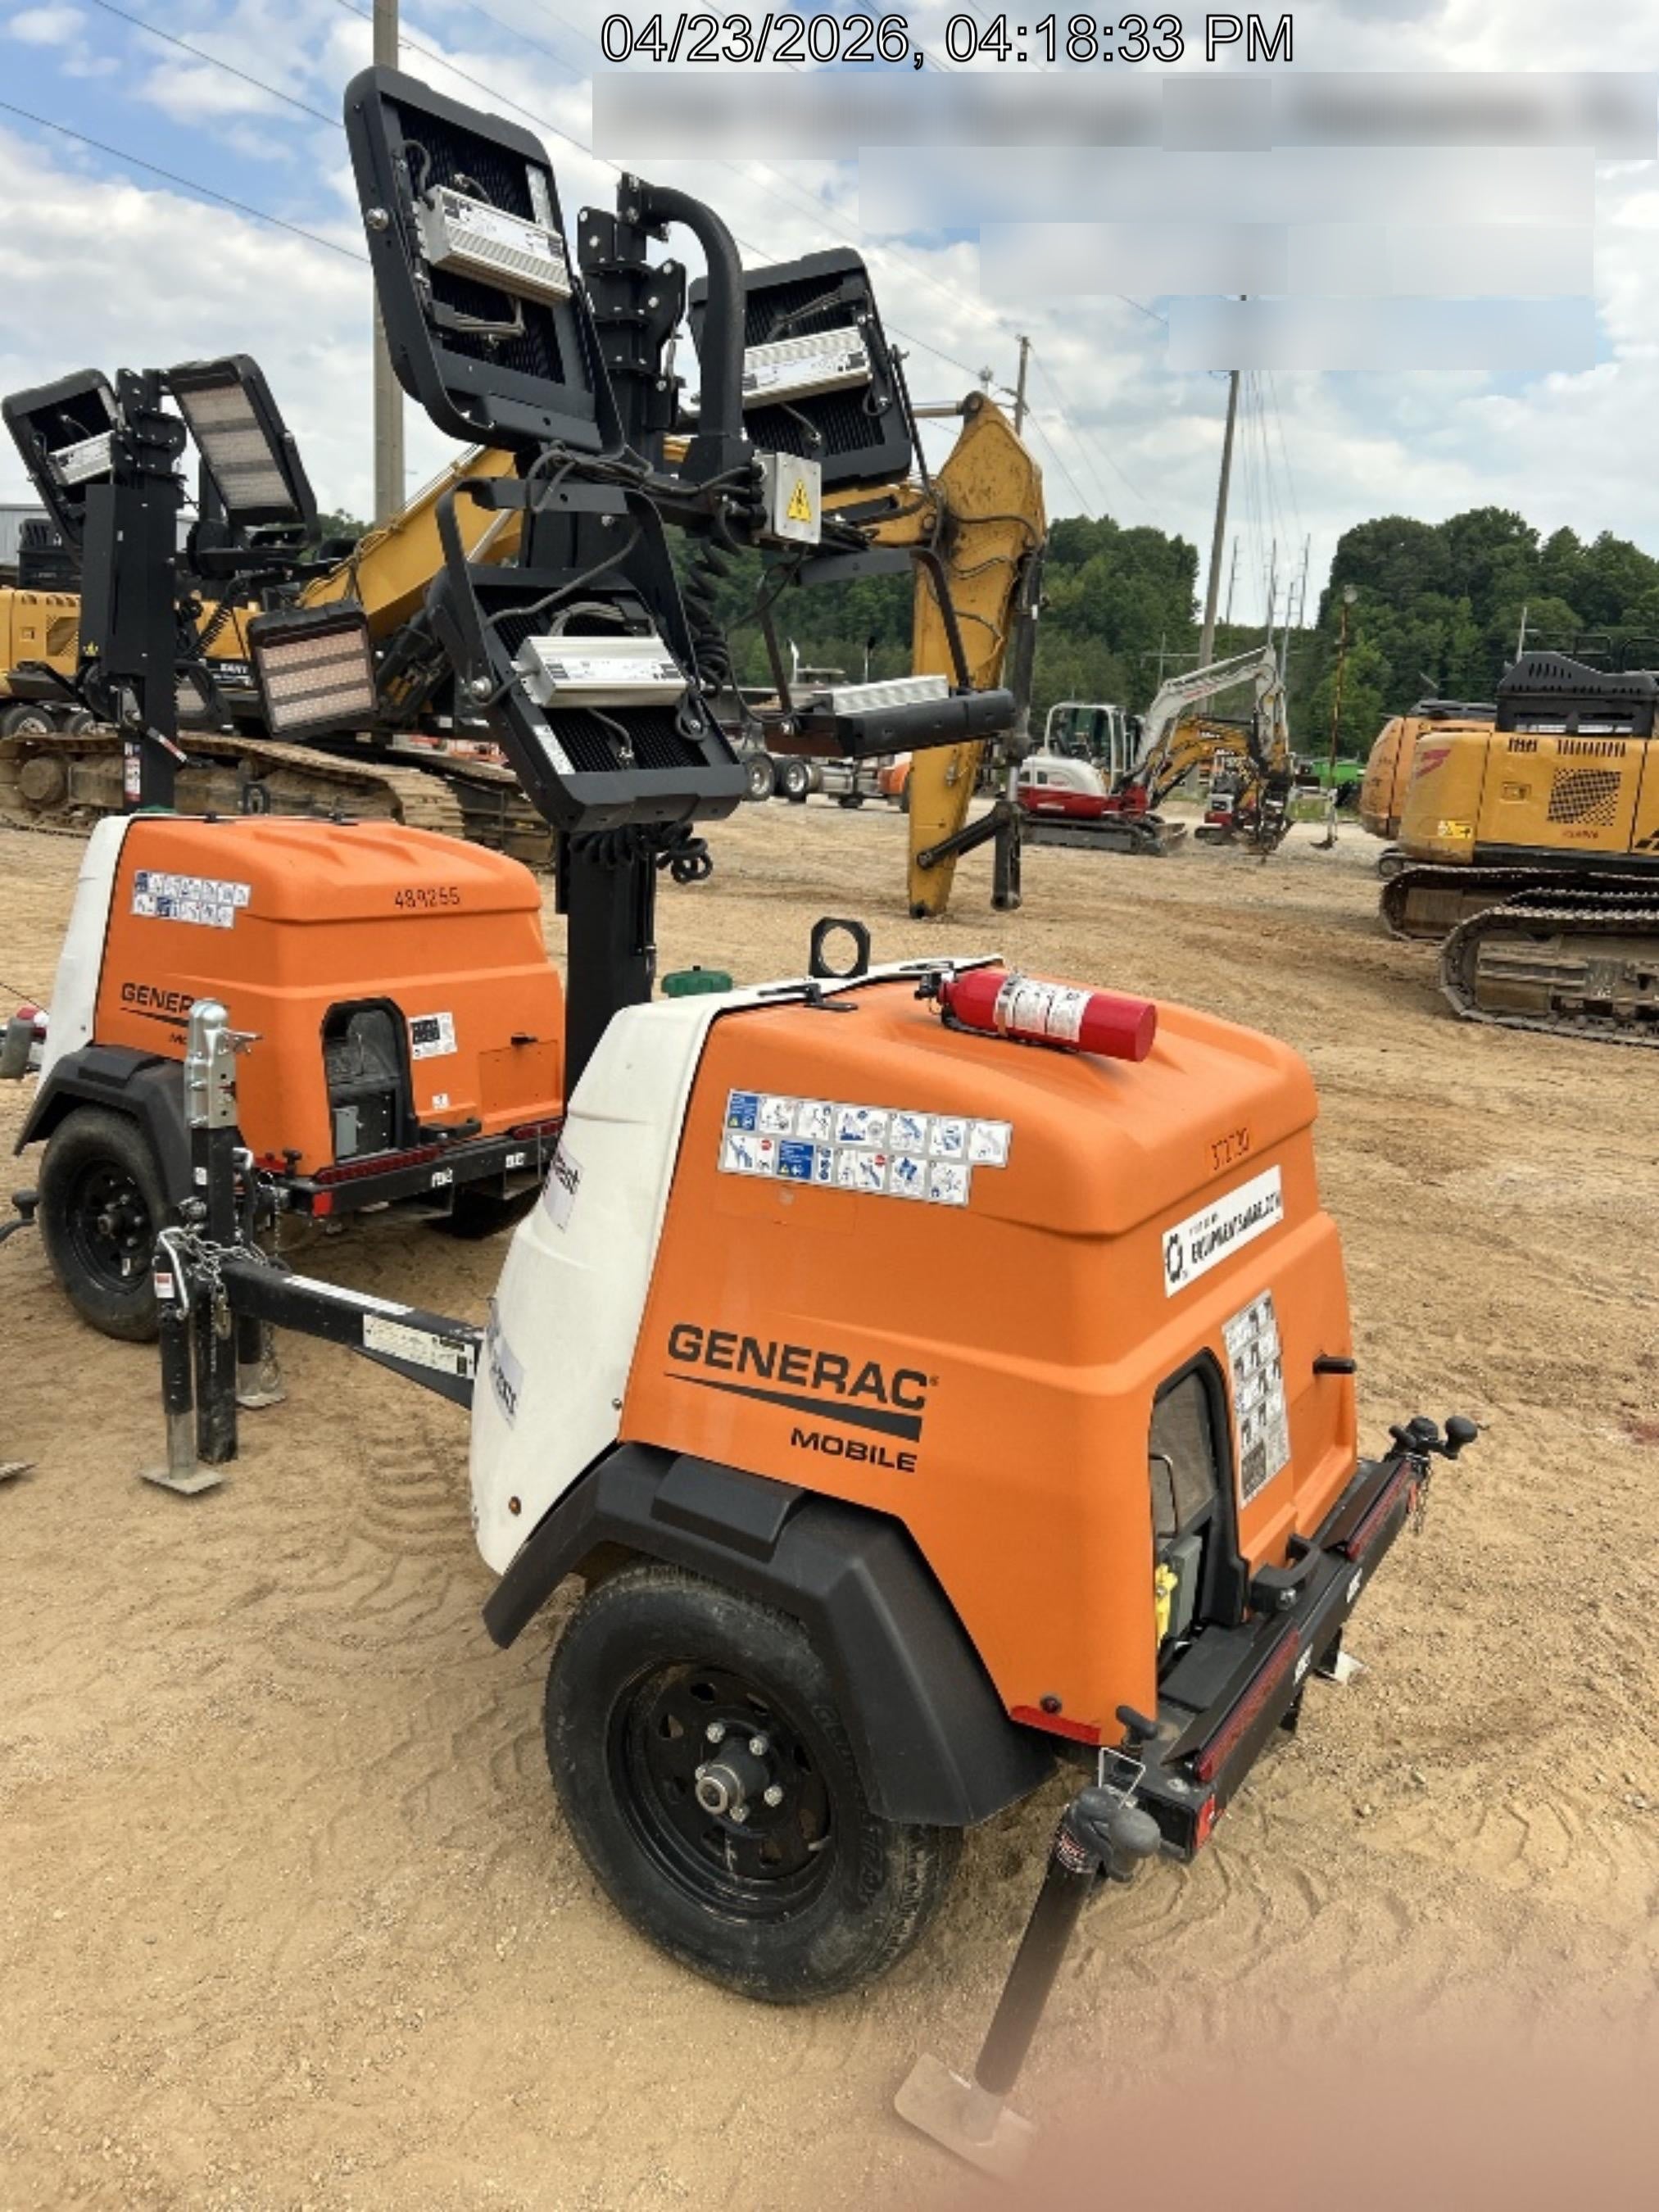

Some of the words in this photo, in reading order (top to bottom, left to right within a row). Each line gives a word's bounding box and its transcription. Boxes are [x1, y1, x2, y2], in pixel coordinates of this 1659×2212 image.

[121, 982, 195, 1013] GENER
[668, 1323, 927, 1411] GENERAC
[791, 1427, 918, 1473] MOBILE
